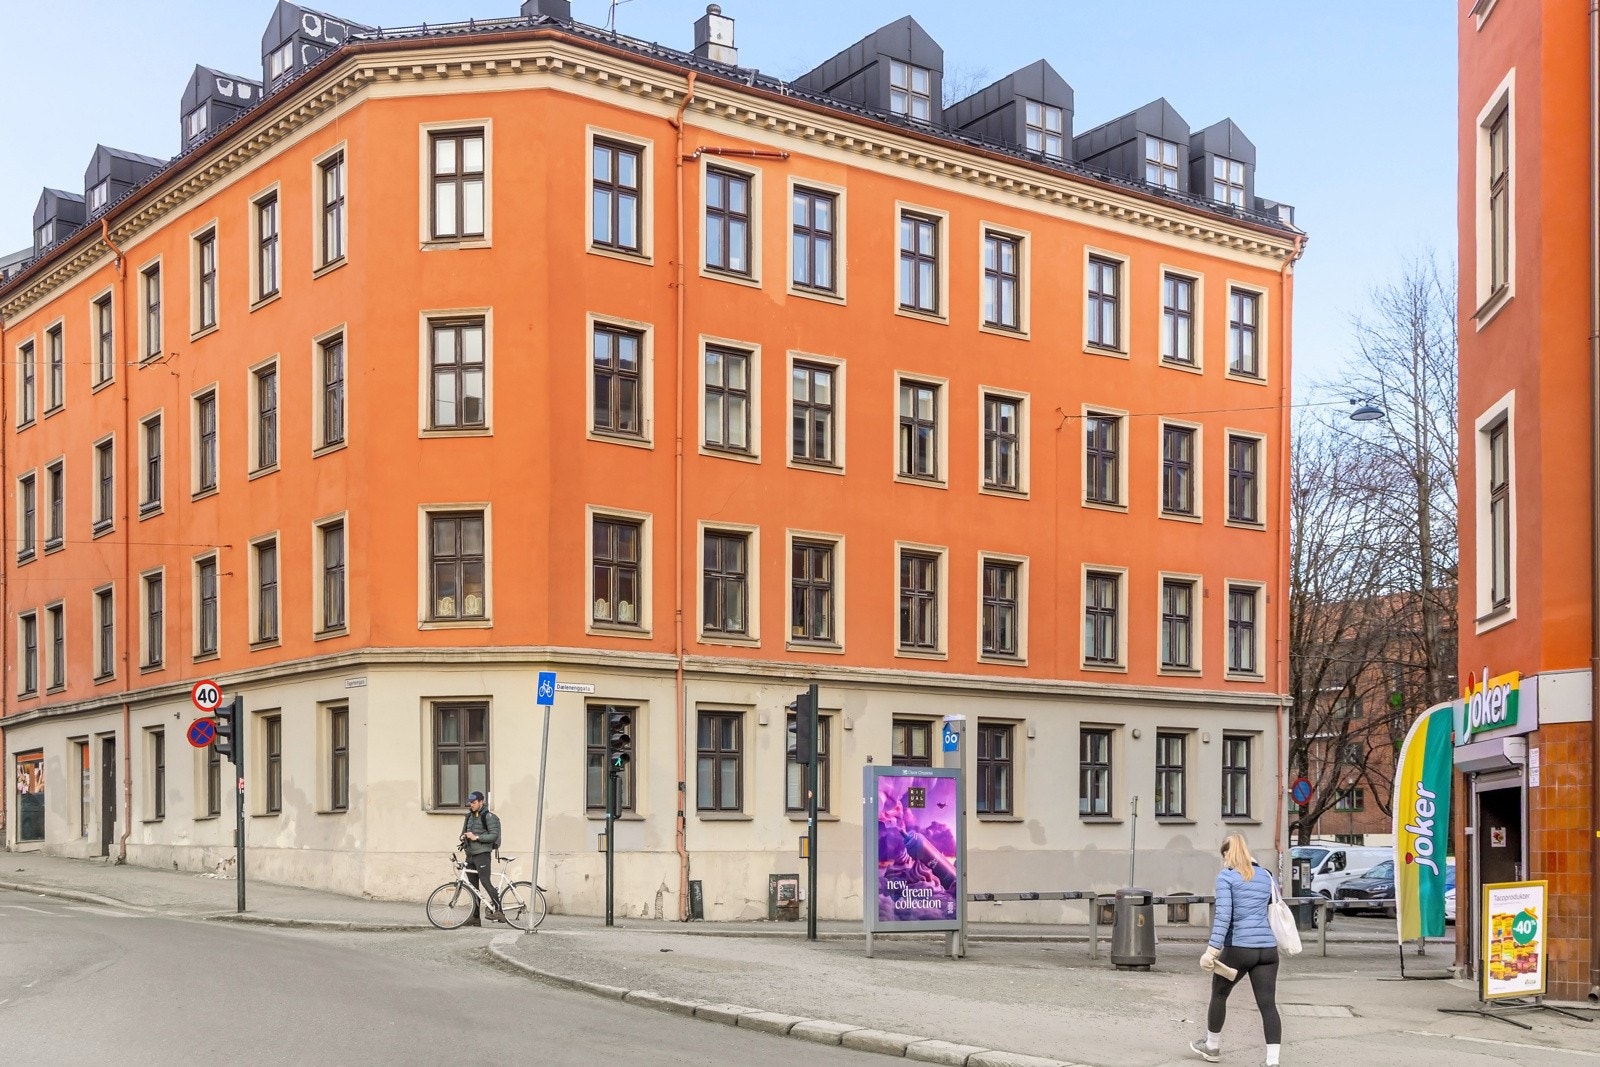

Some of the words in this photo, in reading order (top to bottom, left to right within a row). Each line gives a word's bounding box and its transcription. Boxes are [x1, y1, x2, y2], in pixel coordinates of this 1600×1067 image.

[197, 688, 218, 703] 40
[887, 880, 907, 890] new
[902, 885, 933, 898] dream
[895, 896, 941, 909] collection
[1493, 893, 1530, 902] Tacoprodukter
